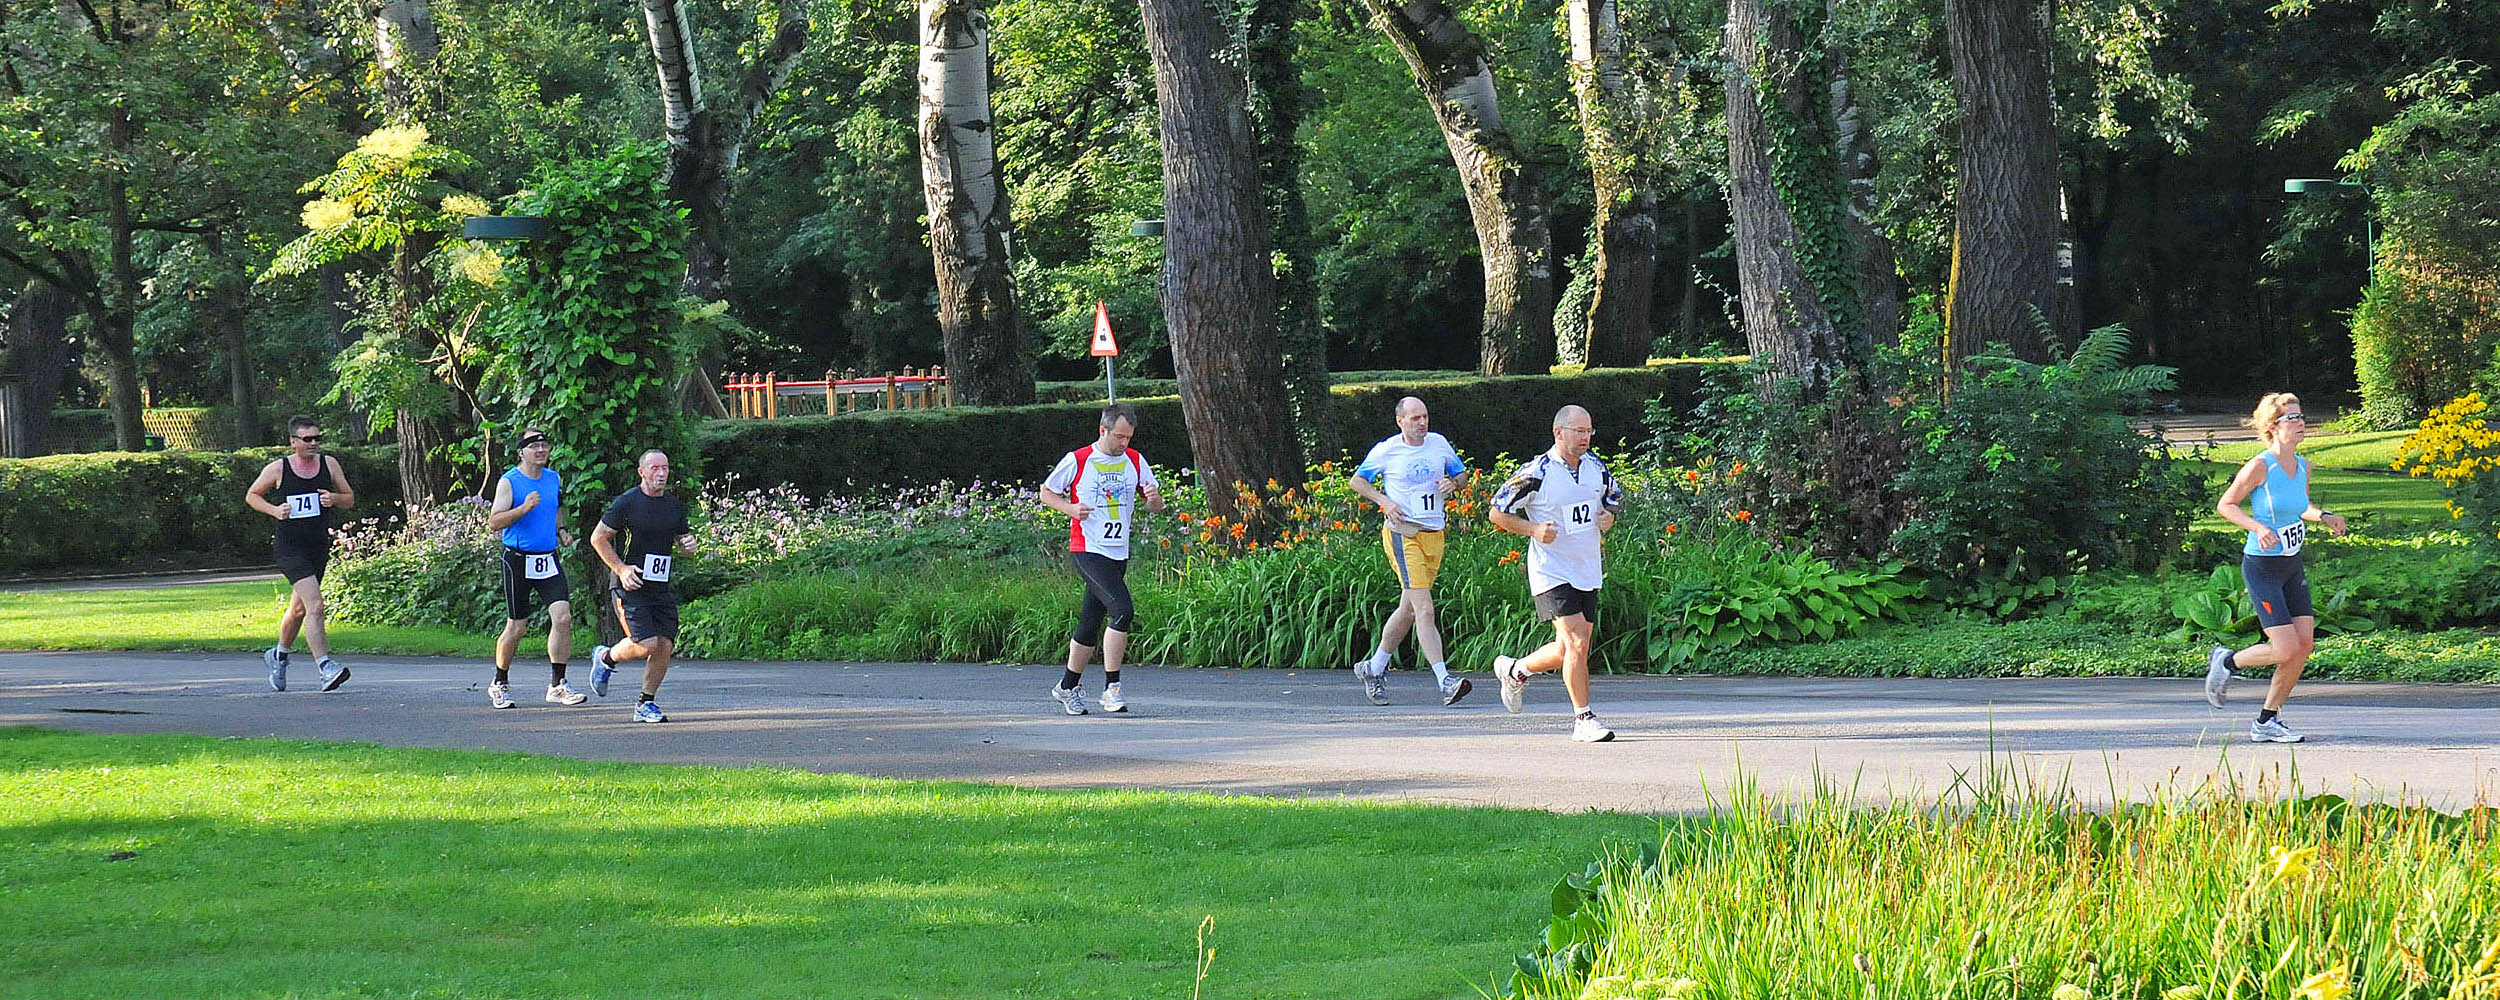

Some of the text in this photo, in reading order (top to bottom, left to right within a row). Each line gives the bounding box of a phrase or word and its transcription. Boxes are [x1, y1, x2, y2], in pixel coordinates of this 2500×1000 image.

[295, 496, 312, 512] 74
[1421, 493, 1435, 511] 11
[1572, 504, 1592, 525] 42
[1103, 522, 1123, 539] 22
[2282, 523, 2303, 549] 155
[535, 556, 549, 573] 81
[652, 557, 667, 575] 84
